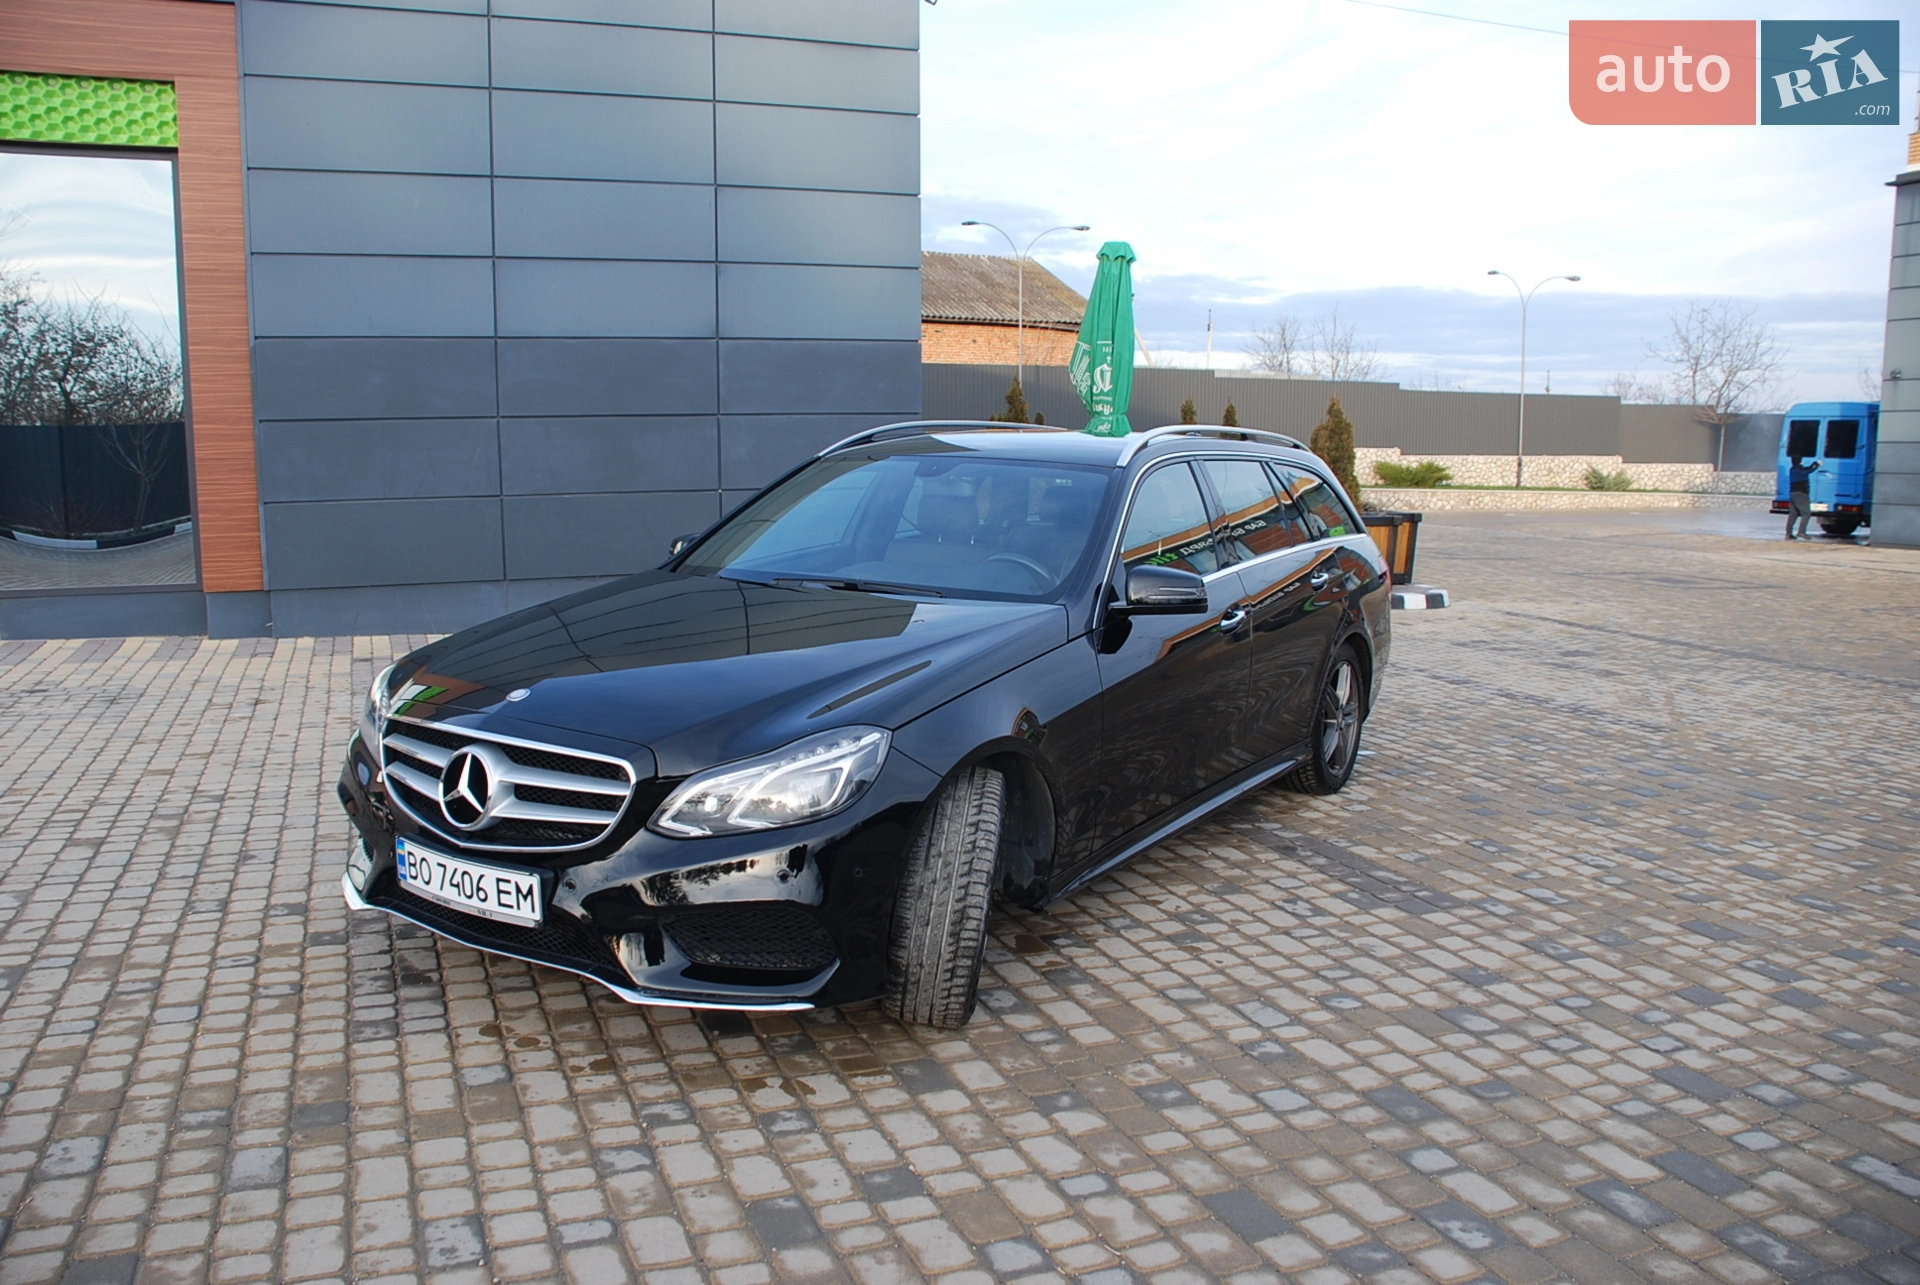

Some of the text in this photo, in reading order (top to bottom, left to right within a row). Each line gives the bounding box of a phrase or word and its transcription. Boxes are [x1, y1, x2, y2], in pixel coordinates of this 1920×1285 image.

[407, 850, 536, 914] BO 7406 EM
